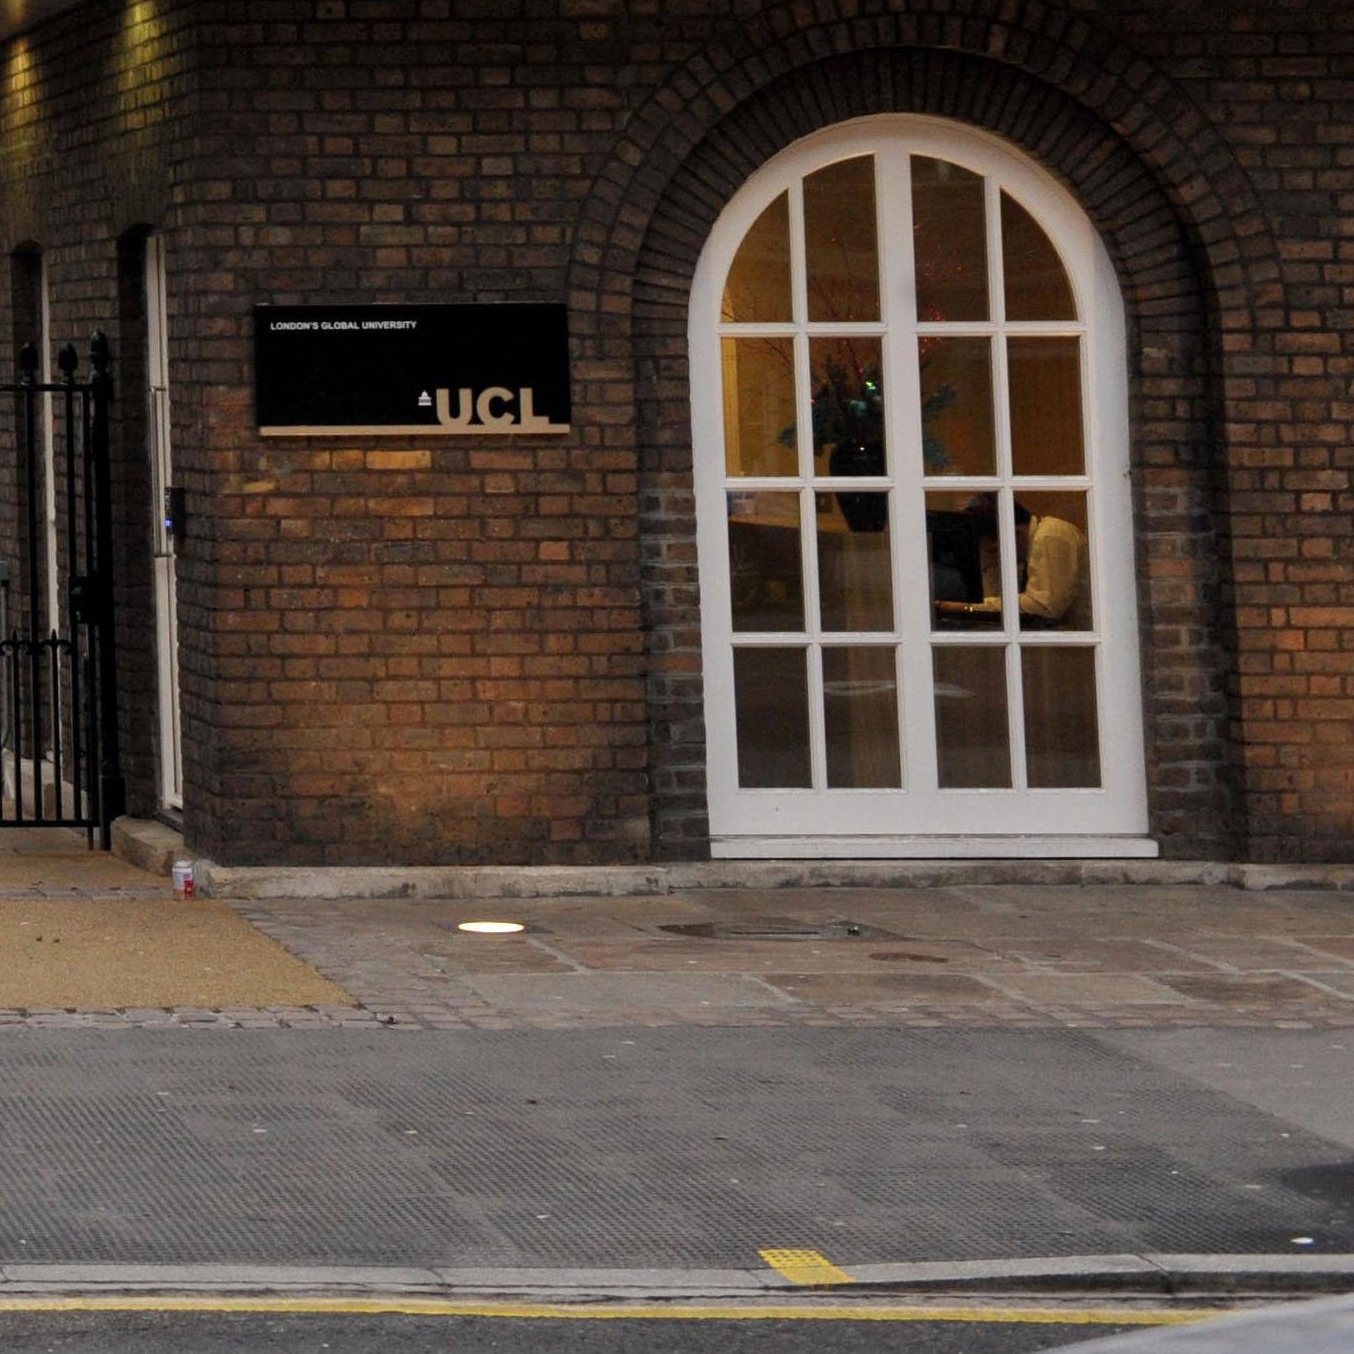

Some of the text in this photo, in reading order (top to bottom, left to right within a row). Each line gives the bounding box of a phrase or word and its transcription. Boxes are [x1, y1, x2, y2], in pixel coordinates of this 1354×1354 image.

[270, 320, 417, 330] LONDON'S GLOBAL UNIVERSITY
[436, 386, 550, 431] UCL
